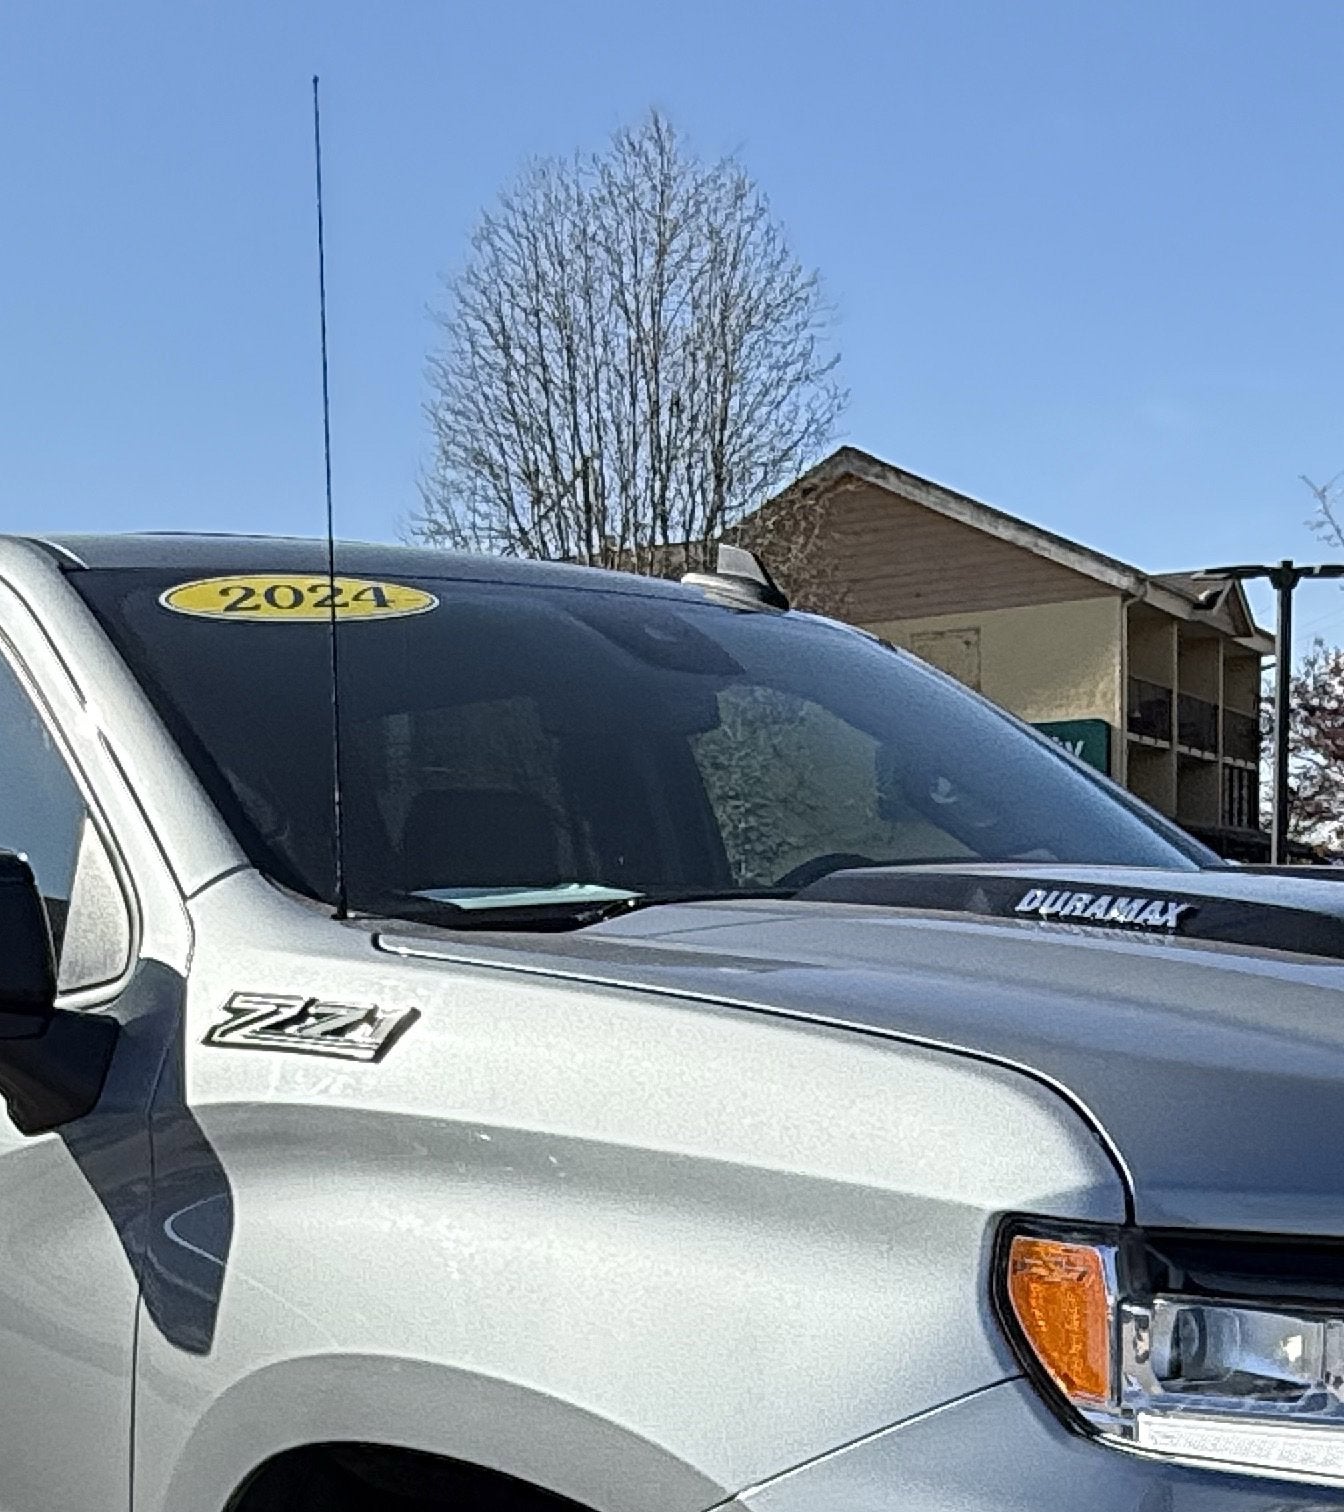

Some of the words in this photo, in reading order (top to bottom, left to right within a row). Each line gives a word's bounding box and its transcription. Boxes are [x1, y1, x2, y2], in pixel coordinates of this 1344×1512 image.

[218, 582, 396, 613] 2024
[1014, 888, 1193, 928] DURAMAX
[200, 990, 422, 1063] Z71
